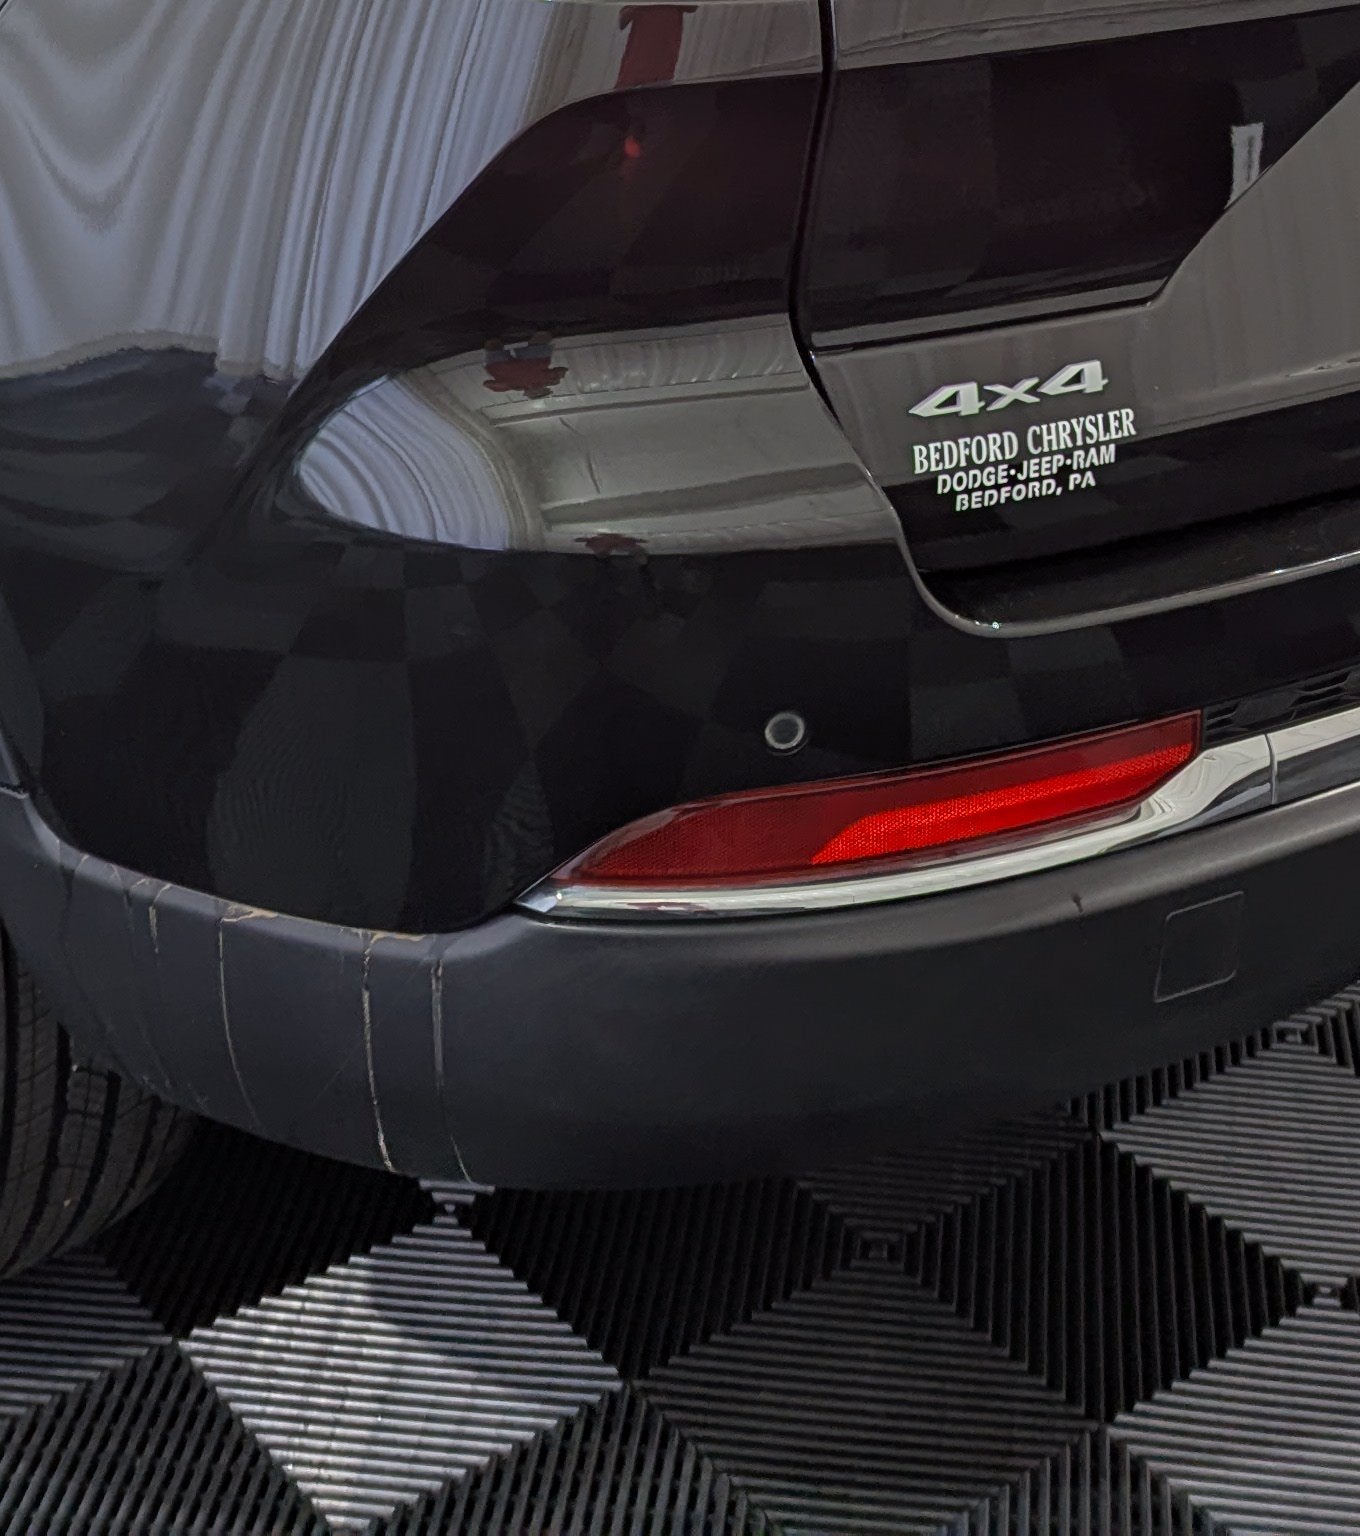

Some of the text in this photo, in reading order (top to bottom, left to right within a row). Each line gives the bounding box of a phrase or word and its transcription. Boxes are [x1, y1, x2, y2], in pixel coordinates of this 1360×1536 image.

[913, 408, 1137, 474] BEDFORD CHRYSLER
[955, 470, 1096, 512] BEDFORD, PA
